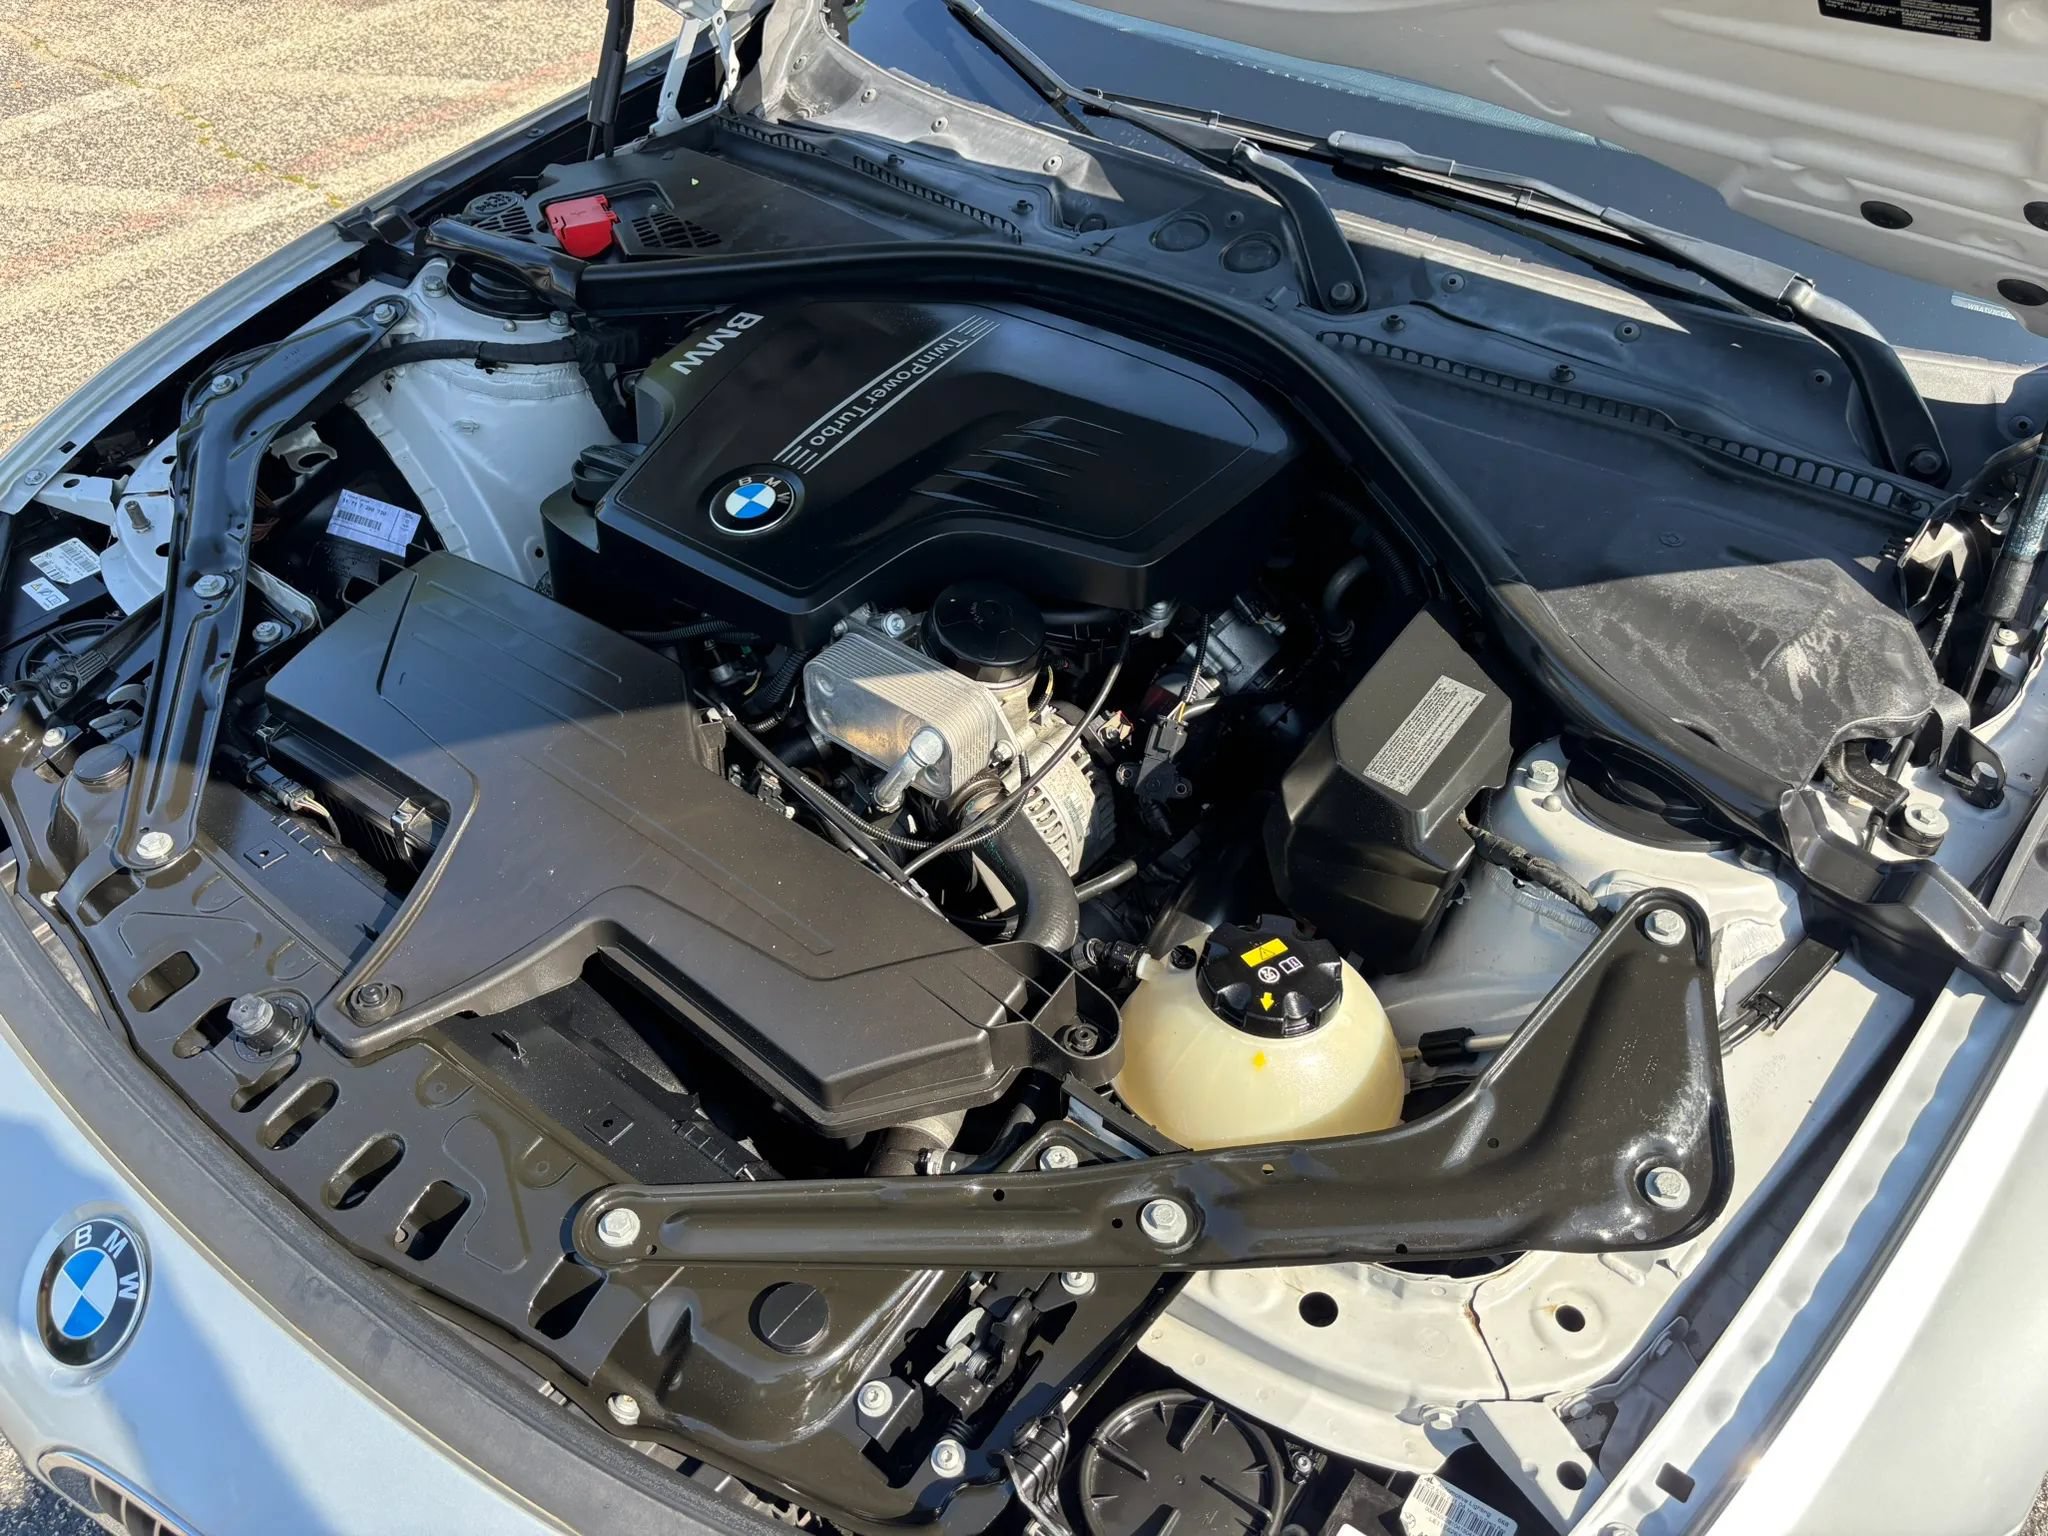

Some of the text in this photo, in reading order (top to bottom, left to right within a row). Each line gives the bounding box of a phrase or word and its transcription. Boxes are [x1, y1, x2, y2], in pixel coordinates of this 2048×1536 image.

[669, 310, 766, 376] BMW
[809, 335, 969, 447] TwinPower Turbo
[737, 475, 789, 506] BMW
[74, 1223, 141, 1300] BMW
